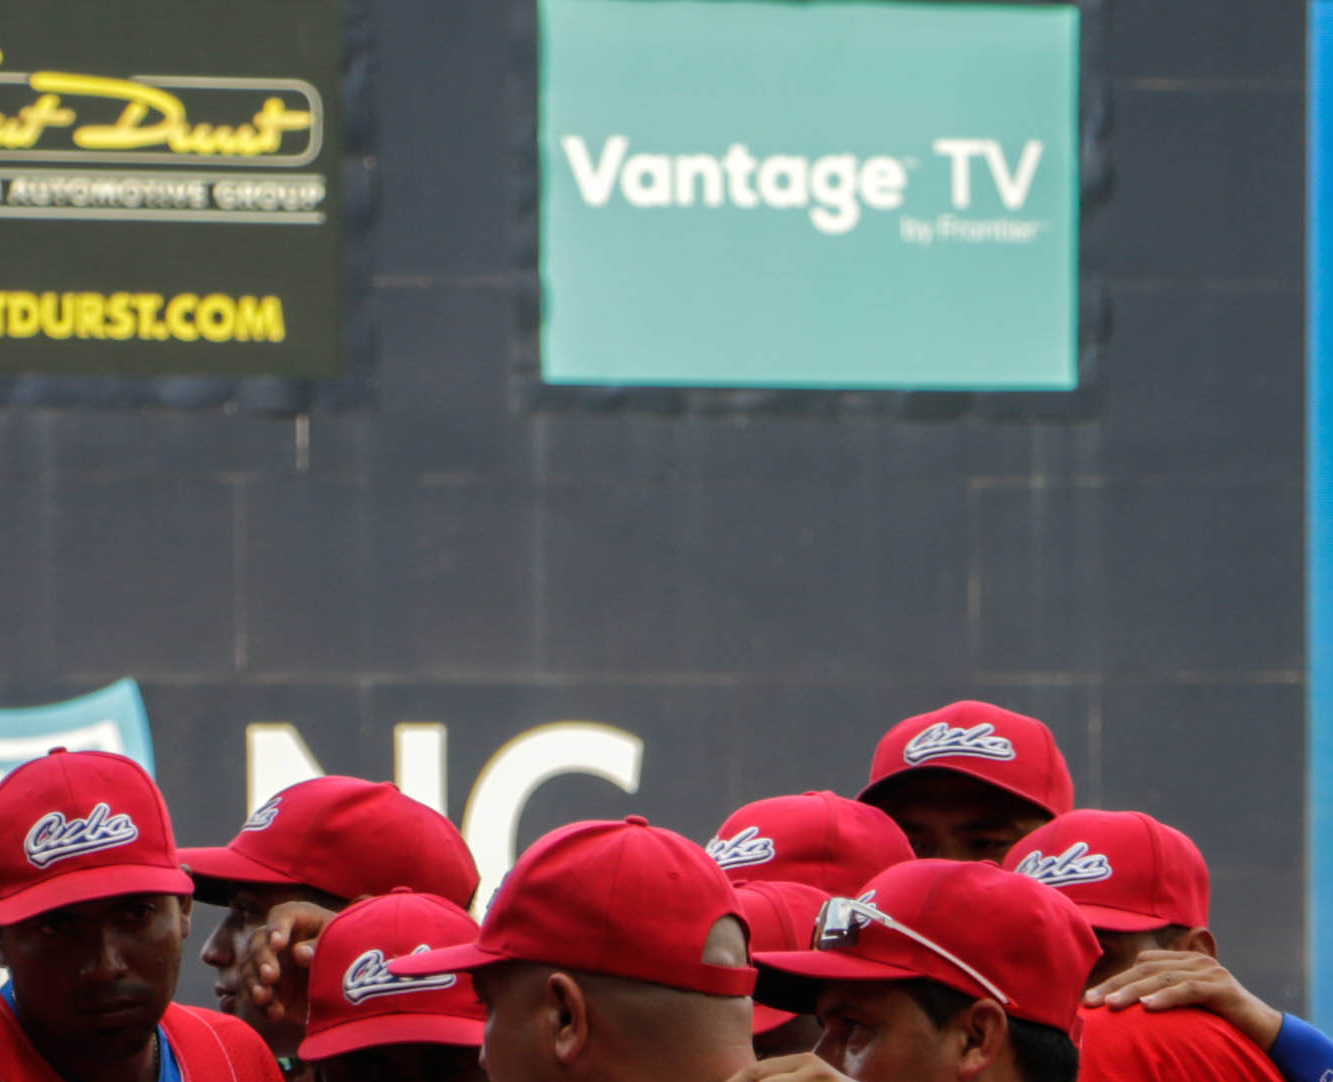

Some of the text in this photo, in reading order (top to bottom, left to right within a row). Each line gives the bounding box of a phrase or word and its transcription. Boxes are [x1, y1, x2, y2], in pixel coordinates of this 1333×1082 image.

[7, 177, 209, 210] AUTOMOTIVE
[562, 134, 1043, 235] Vantage TV
[903, 721, 1017, 767] Cuba
[23, 801, 140, 870] Cuba
[705, 826, 776, 872] uba
